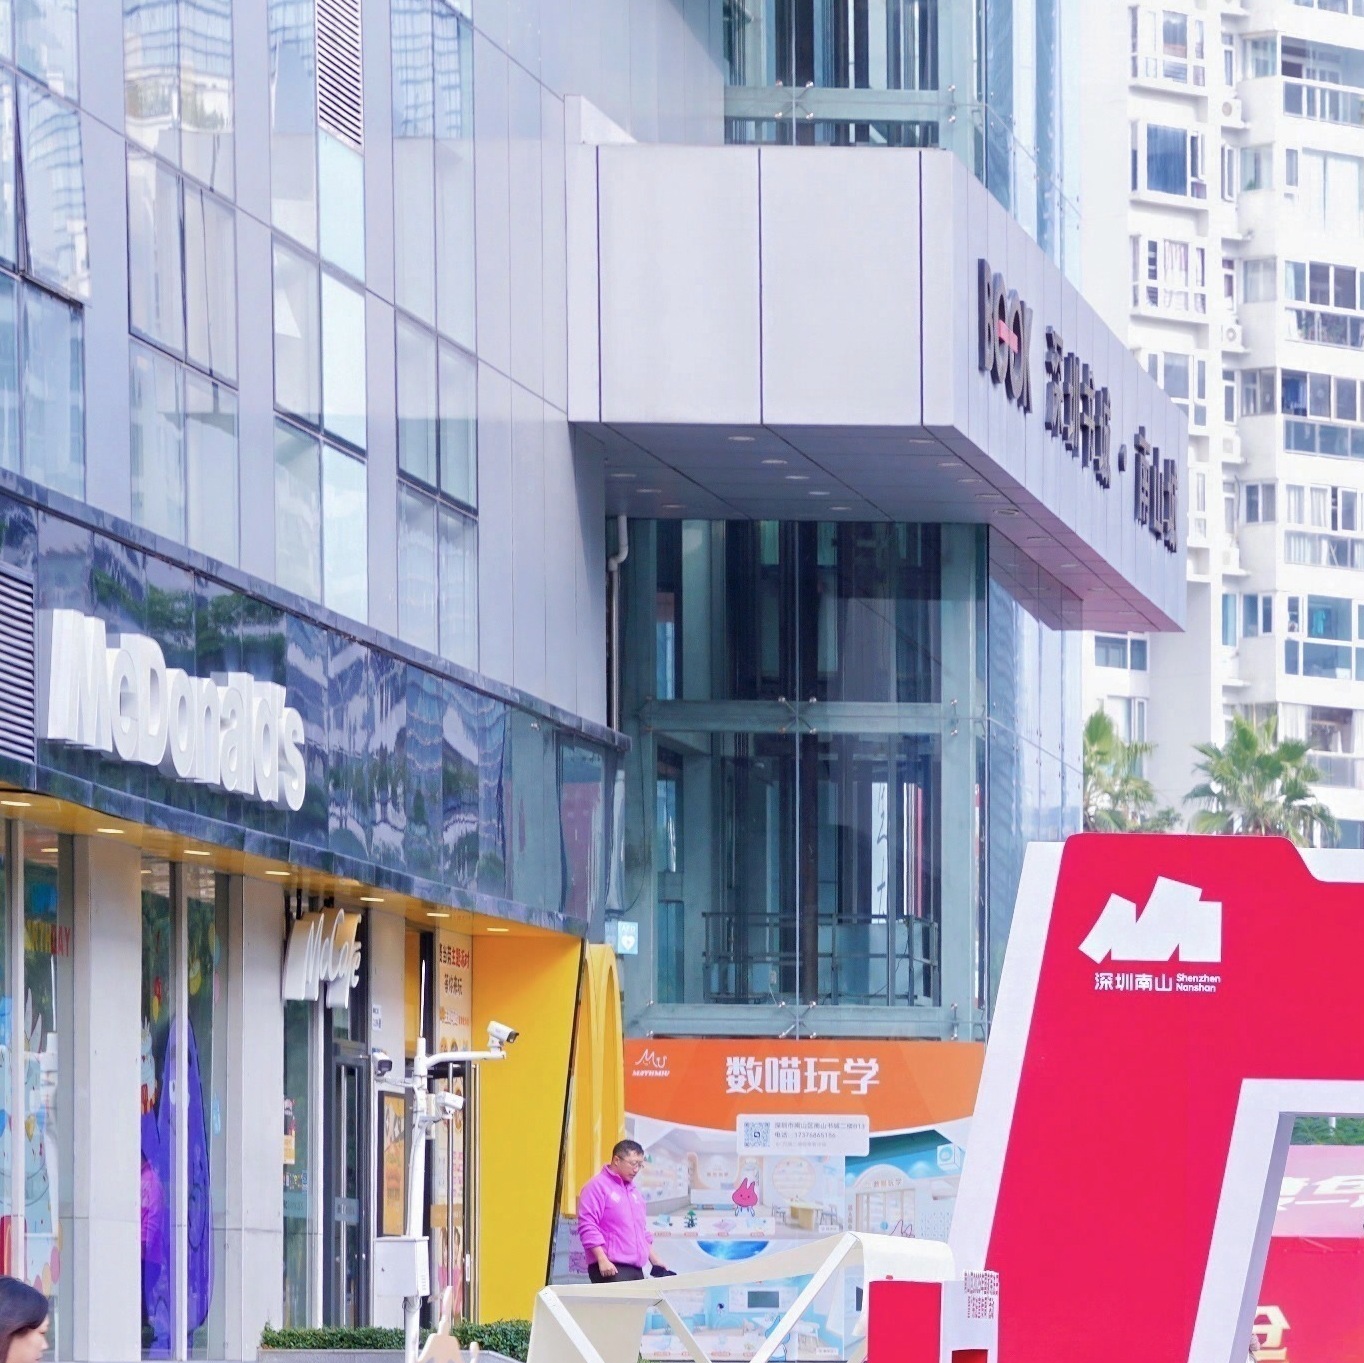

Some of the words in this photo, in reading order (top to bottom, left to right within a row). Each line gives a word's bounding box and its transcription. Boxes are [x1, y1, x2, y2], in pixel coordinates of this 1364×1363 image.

[978, 258, 1033, 414] BOOK
[41, 608, 307, 812] McDonald's
[1094, 972, 1173, 992] 深圳南山
[1176, 972, 1221, 983] Shenzhen
[1176, 984, 1216, 993] Nanshan
[725, 1056, 880, 1095] 数喵玩学
